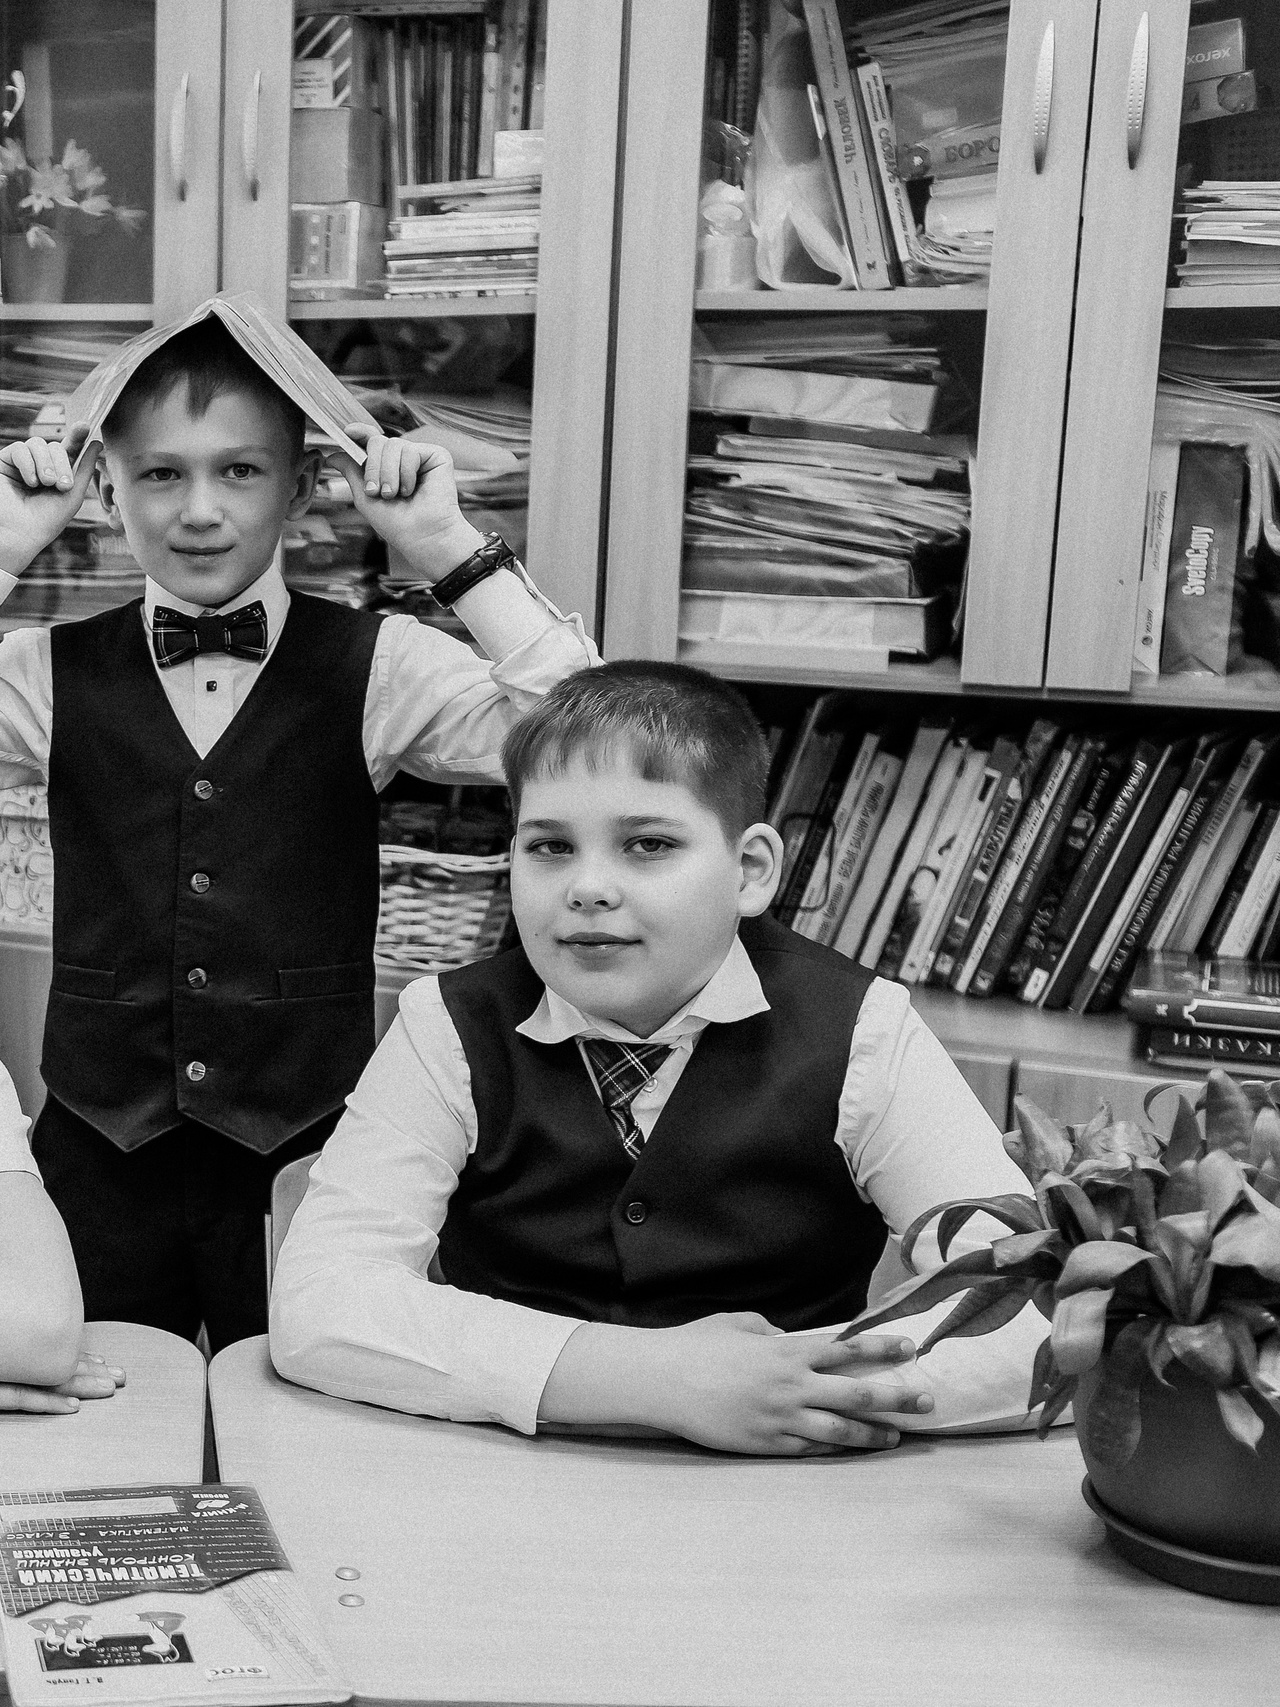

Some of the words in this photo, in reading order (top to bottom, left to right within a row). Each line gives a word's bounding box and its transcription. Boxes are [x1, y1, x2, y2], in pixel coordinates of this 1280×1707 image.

[1186, 47, 1231, 66] xerox
[831, 96, 858, 165] ЧЕЛОВЕК
[877, 126, 901, 185] СЛОВАРЬ
[1181, 525, 1215, 597] SvetoCopy
[1119, 759, 1149, 801] НОВАЯ
[977, 795, 1020, 875] ЖИВОТНЫХ
[1128, 860, 1175, 936] КОМНАТНЫХ
[1173, 1032, 1280, 1056] КАЗКИ
[5, 1531, 54, 1540] КЛАСС
[58, 1531, 71, 1539] 3
[98, 1526, 189, 1537] МАТЕМАТИКА
[15, 1557, 88, 1569] ЗНАНИЙ
[97, 1553, 195, 1567] КОНТРОЛЬ
[18, 1563, 203, 1585] ТЕМАТИЧЕСКИЙ
[208, 1666, 263, 1677] ФГОС
